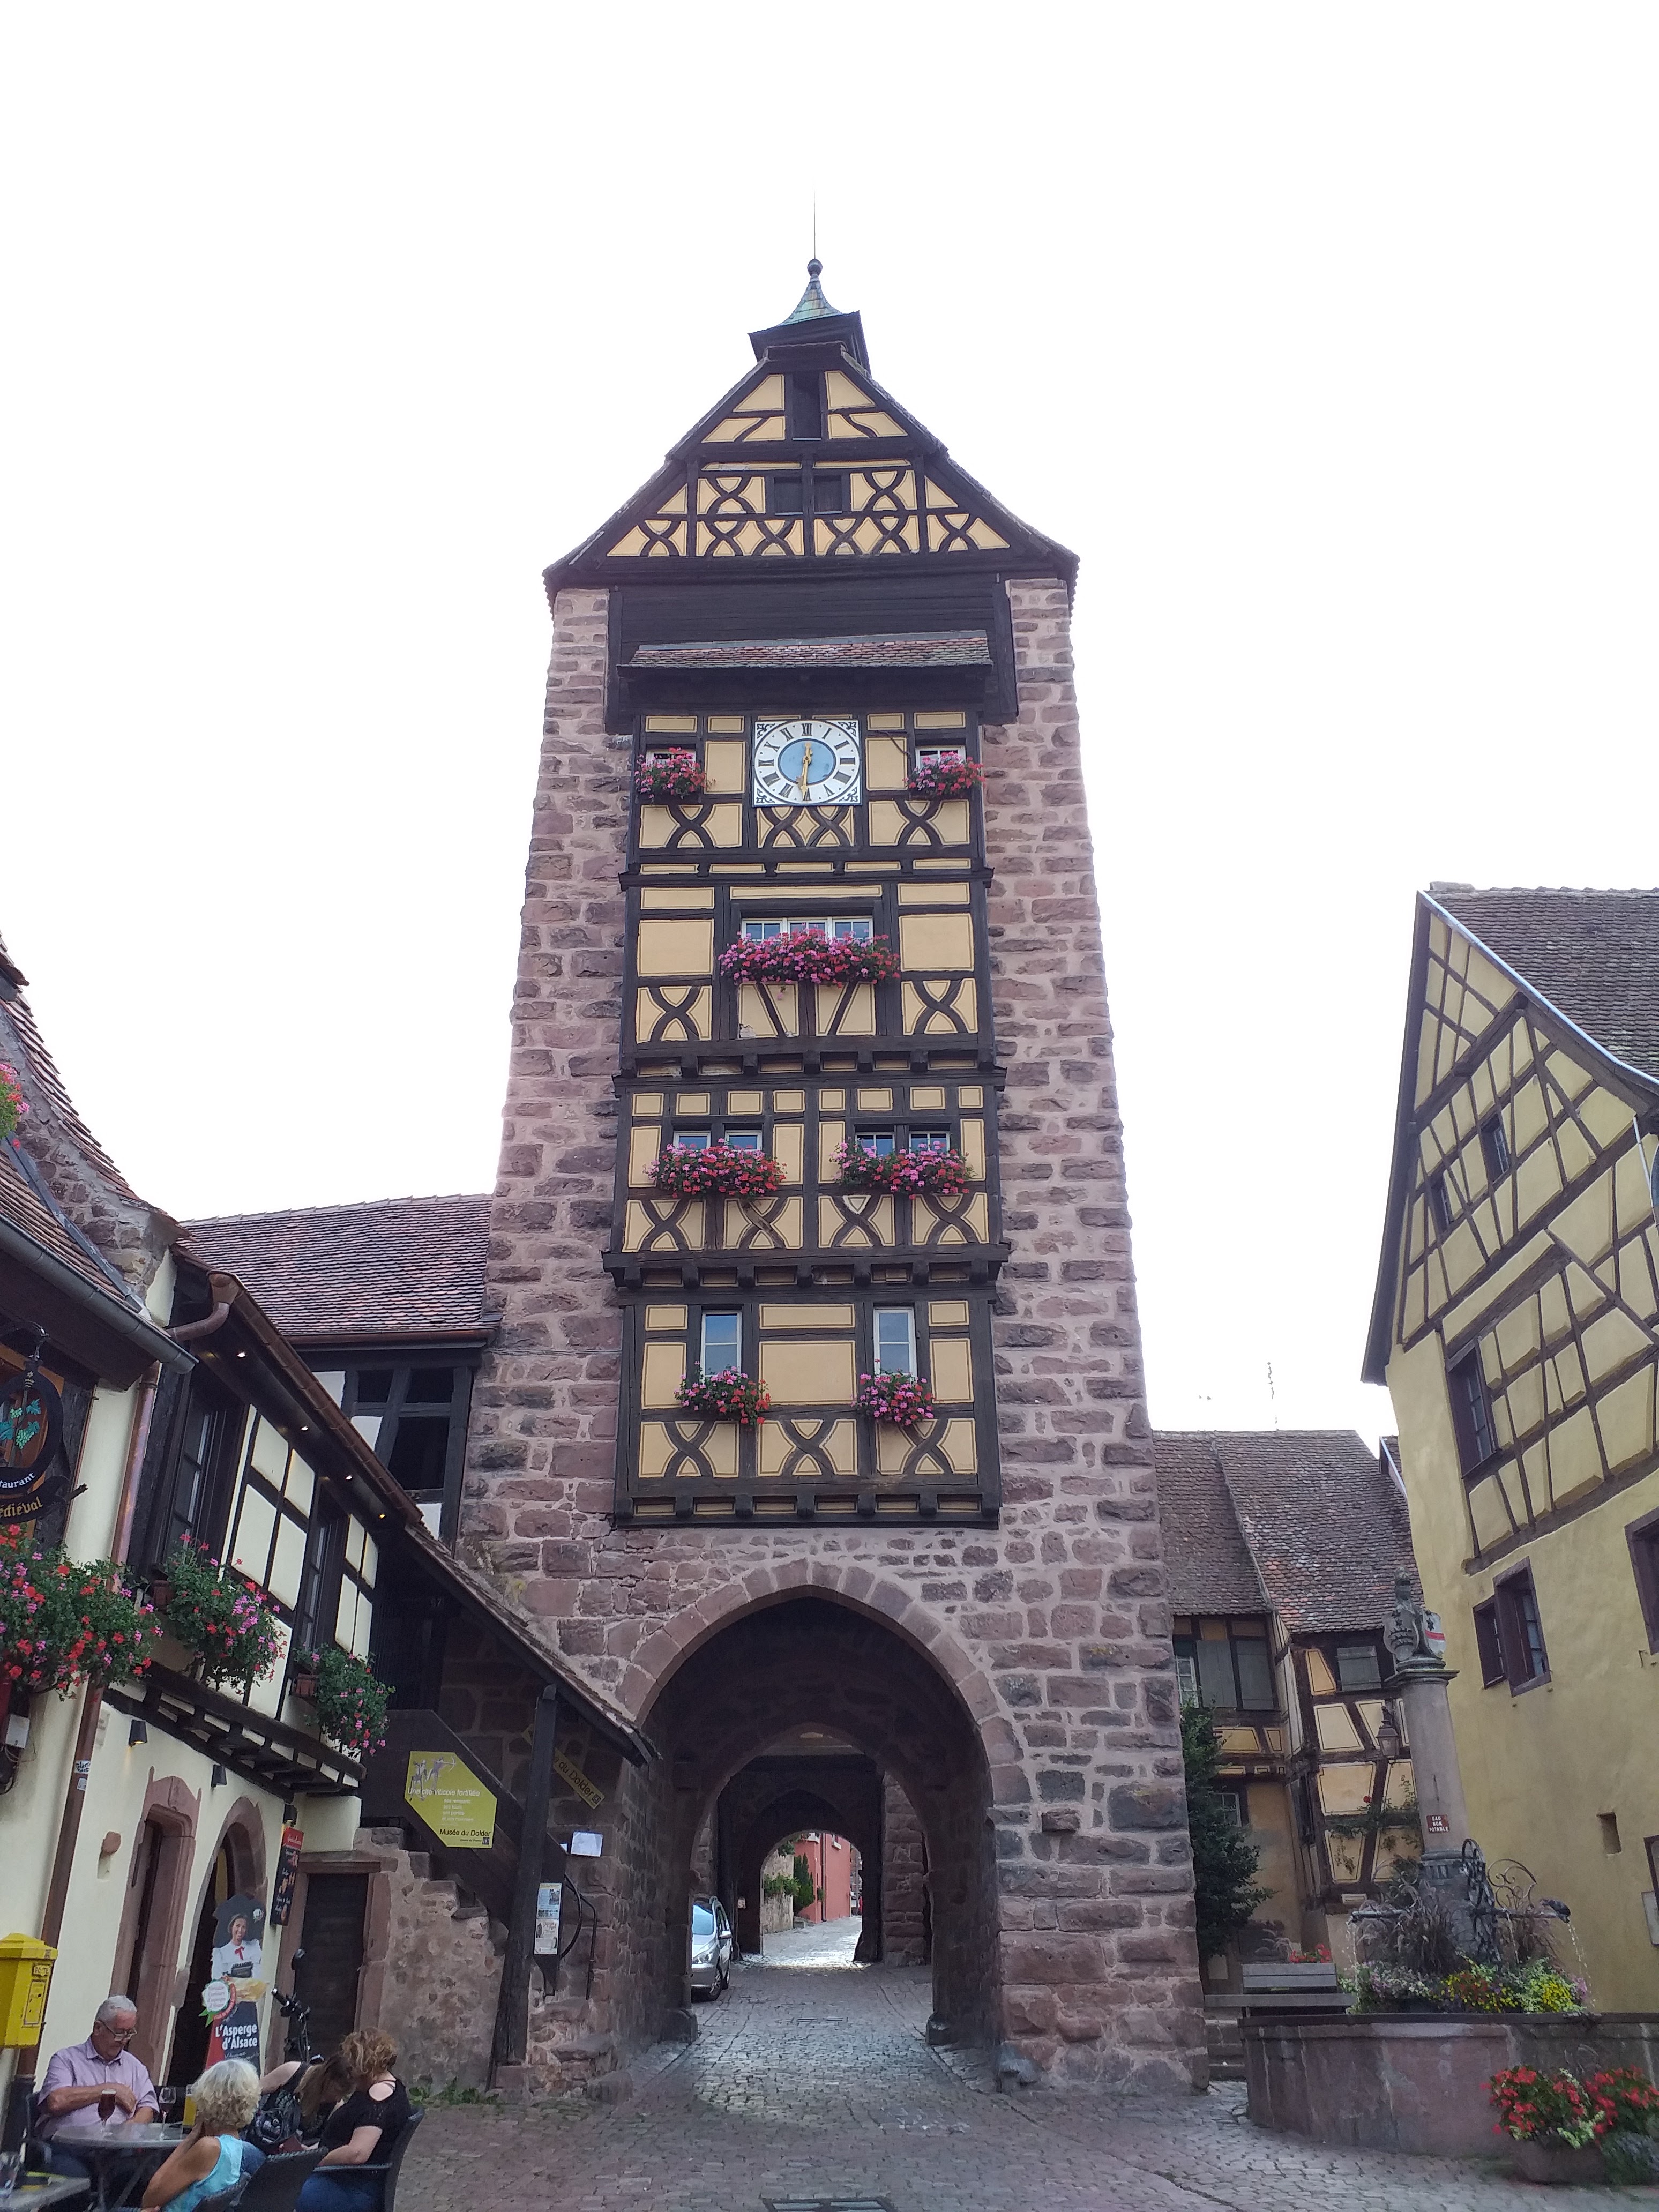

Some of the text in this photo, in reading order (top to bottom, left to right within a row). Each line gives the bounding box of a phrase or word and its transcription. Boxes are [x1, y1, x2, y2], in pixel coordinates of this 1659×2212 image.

[780, 728, 794, 742] XI
[801, 723, 812, 736] XII
[822, 728, 832, 739] I
[764, 741, 781, 752] X
[823, 784, 835, 797] V
[568, 1770, 595, 1798] Dolder
[457, 1789, 480, 1797] fortifiée
[439, 1828, 460, 1836] Musée
[215, 2024, 257, 2037] L'Asperge
[222, 2036, 258, 2050] d'Alsace
